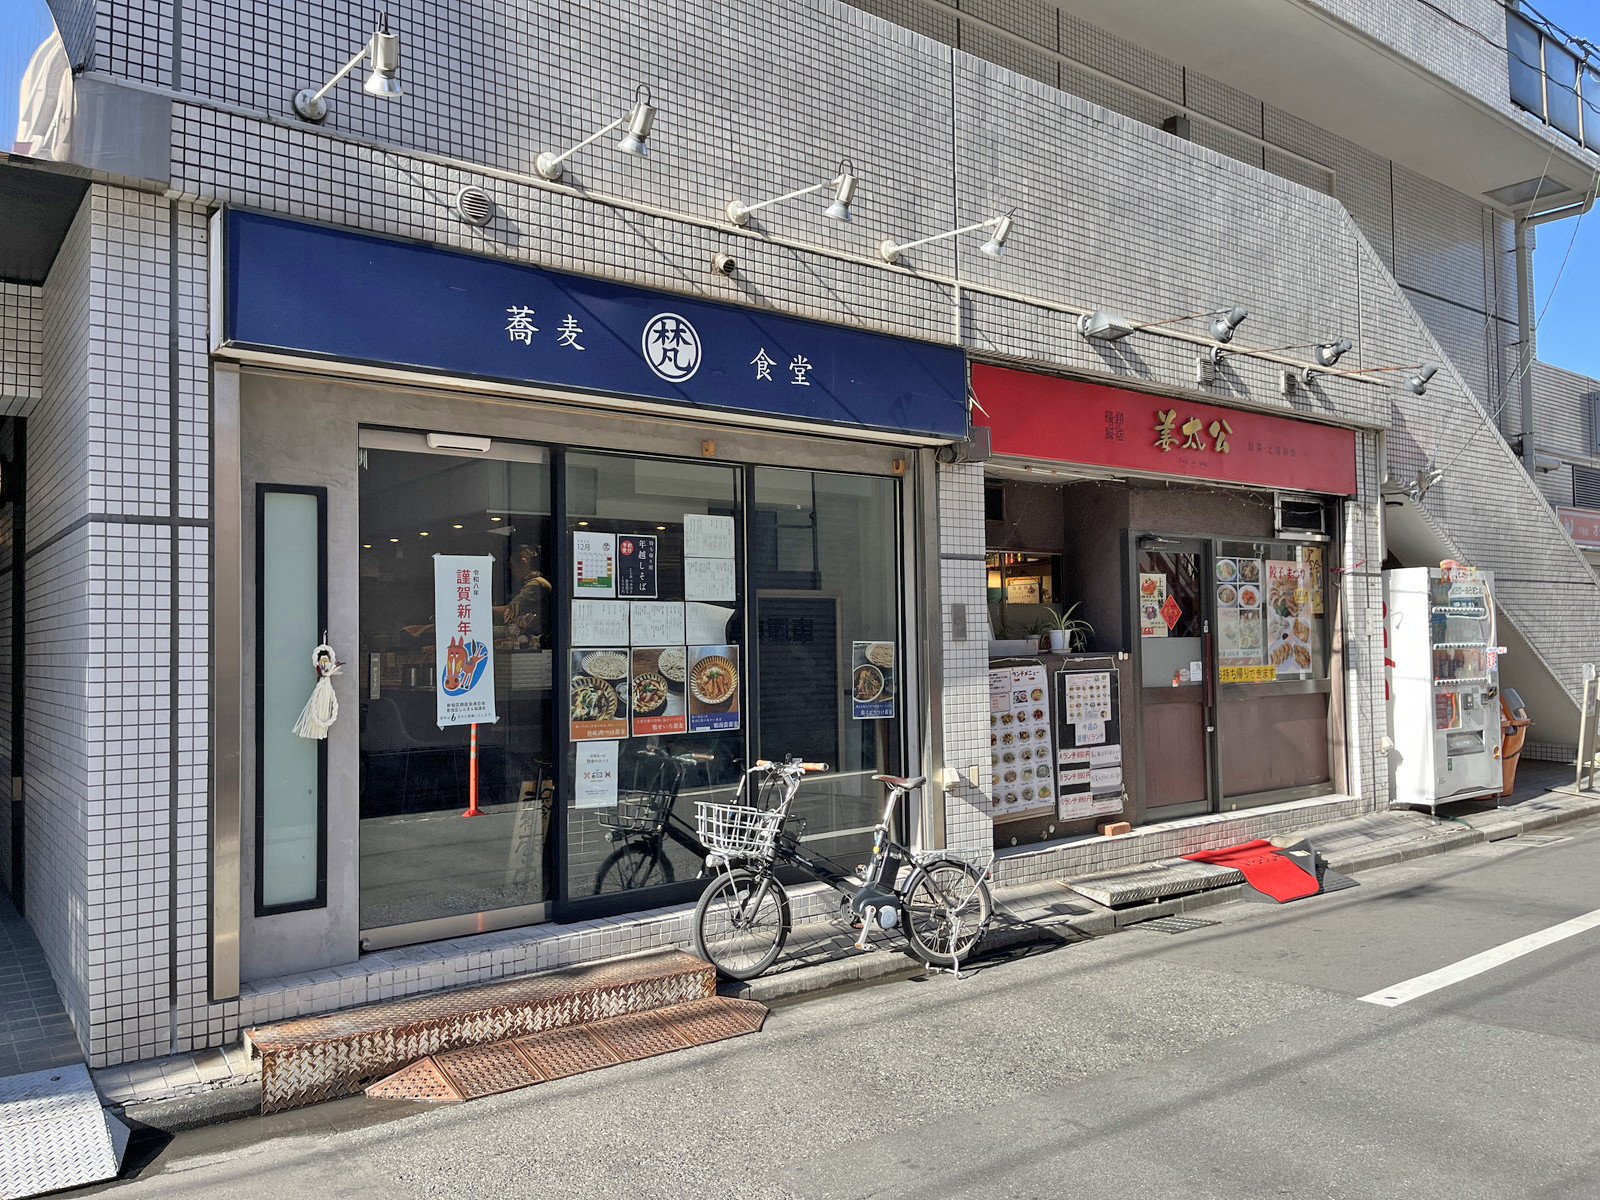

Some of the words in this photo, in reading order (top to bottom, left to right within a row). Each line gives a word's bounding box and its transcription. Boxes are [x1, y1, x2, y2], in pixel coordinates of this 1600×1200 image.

[504, 305, 586, 350] 蕎麦
[750, 347, 813, 386] 食堂
[1153, 408, 1234, 454] 姜太公
[638, 540, 647, 591] 年越しそば
[456, 569, 472, 636] 謹賀新年
